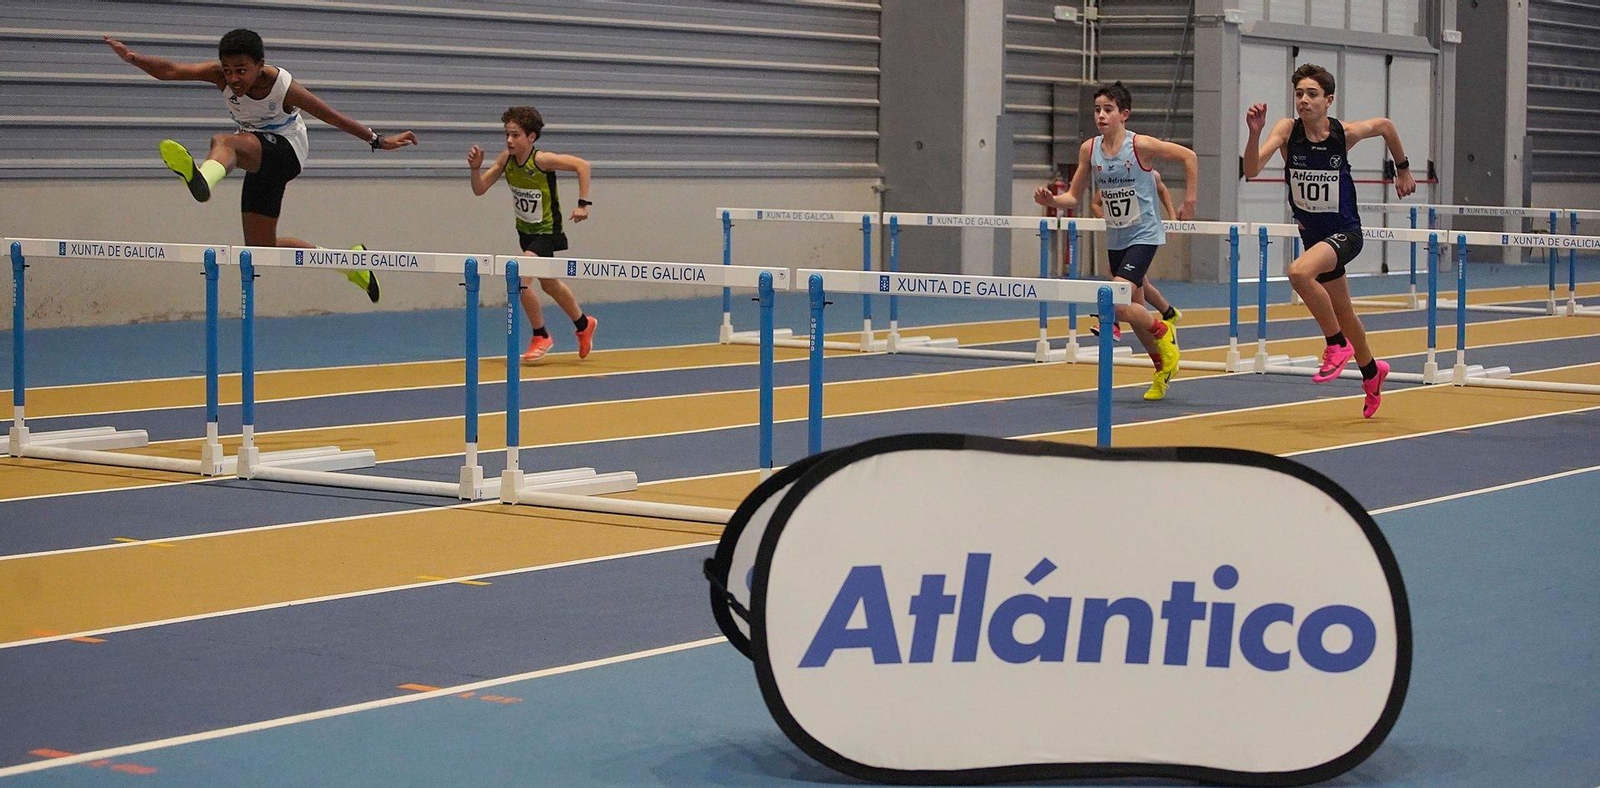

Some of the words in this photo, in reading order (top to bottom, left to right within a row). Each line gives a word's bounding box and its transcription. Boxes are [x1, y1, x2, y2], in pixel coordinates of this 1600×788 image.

[1291, 171, 1338, 182] Atlántico
[1298, 182, 1330, 201] 101
[513, 195, 538, 213] 207
[1105, 198, 1131, 217] 167
[765, 211, 791, 219] XUNTA
[792, 212, 802, 220] DE
[804, 212, 835, 221] GALICIA
[936, 217, 963, 225] XUNTA
[964, 217, 975, 226] DE
[977, 218, 1010, 227] GALICIA
[70, 243, 105, 256] XUNTA
[107, 245, 121, 257] DE
[124, 246, 165, 259] GALICIA
[1513, 236, 1545, 245] XUNTA
[1547, 237, 1560, 247] DE
[1562, 239, 1600, 249] GALICIA
[309, 252, 348, 265] XUNTA
[352, 253, 367, 266] DE
[371, 254, 419, 268] GALICIA
[583, 262, 627, 278] XUNTA
[631, 264, 648, 279] DE
[652, 266, 706, 282] GALICIA
[897, 278, 946, 293] XUNTA
[953, 281, 972, 295] DE
[976, 282, 1037, 298] GALICIA
[798, 553, 1376, 673] Atlántico
